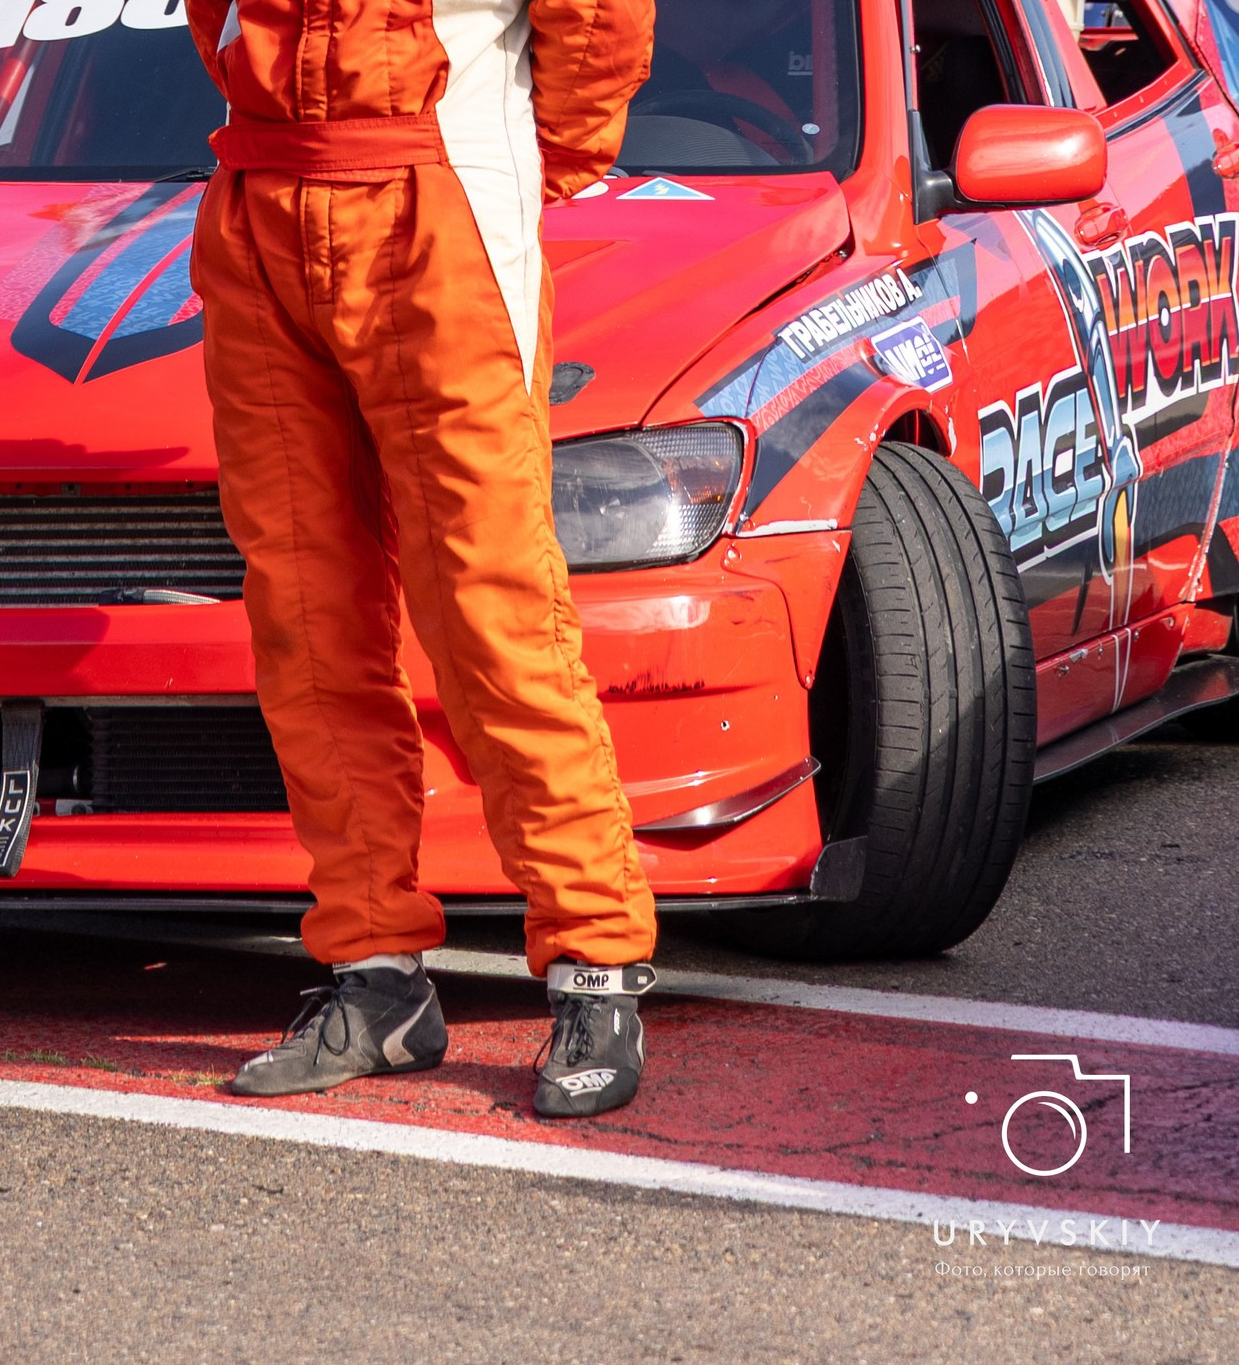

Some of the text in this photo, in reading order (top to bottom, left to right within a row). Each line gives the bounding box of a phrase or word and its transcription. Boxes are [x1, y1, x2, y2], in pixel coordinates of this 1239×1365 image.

[778, 273, 907, 359] ГРАБЕЛЬНИКОВ
[1091, 226, 1238, 409] WORK
[980, 381, 1105, 559] RACE
[573, 972, 609, 988] OMP
[561, 1072, 615, 1091] OMP
